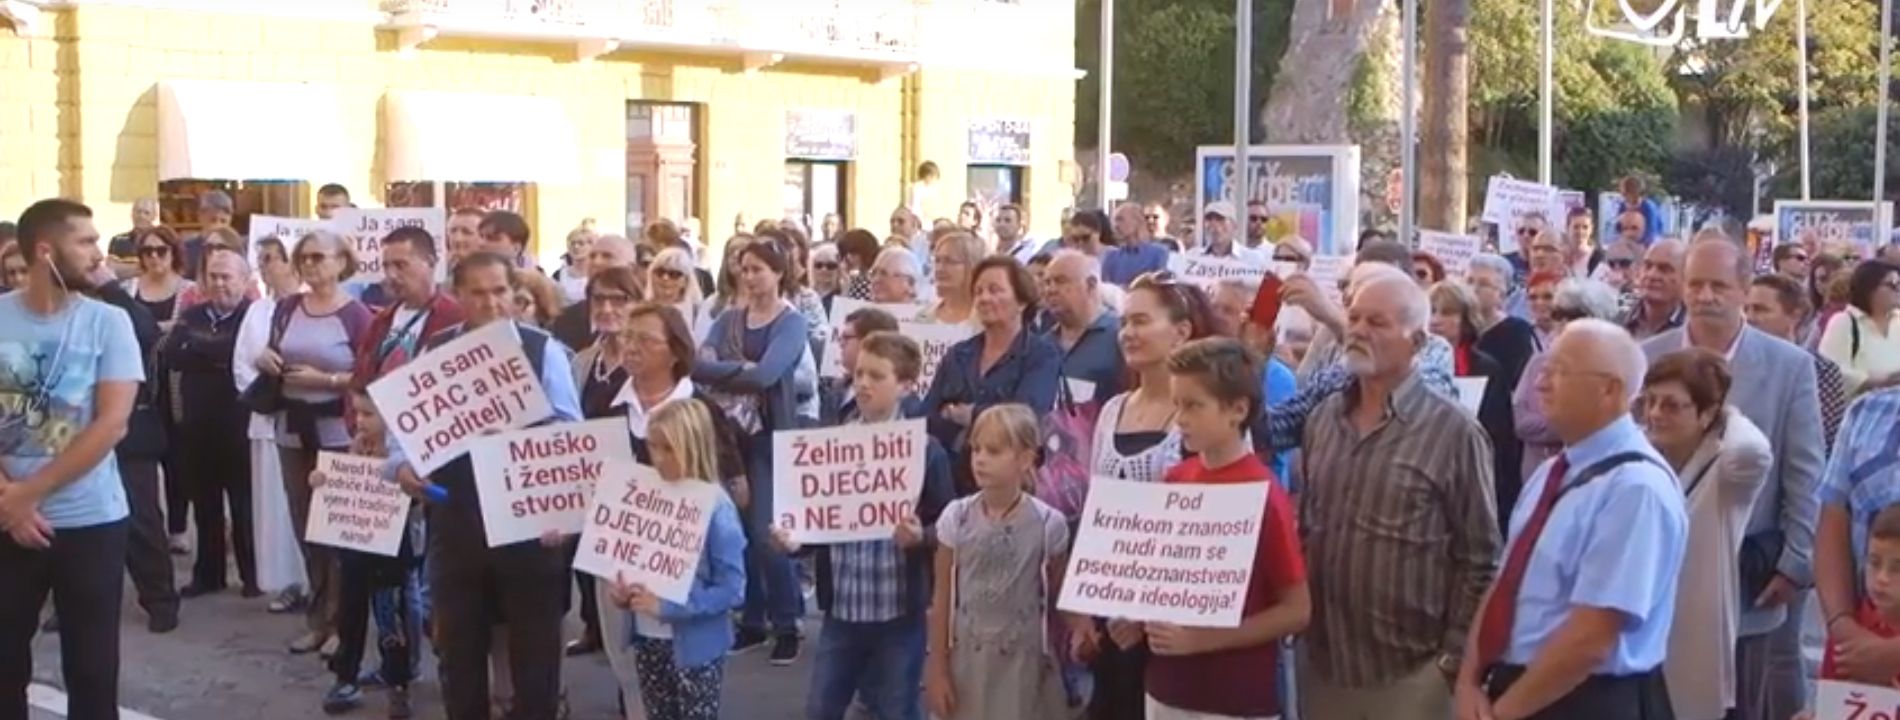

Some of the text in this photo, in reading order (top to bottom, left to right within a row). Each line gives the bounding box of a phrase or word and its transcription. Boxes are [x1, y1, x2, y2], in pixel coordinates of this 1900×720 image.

[1220, 161, 1281, 181] CTY
[1220, 177, 1300, 201] GIDE
[356, 216, 379, 231] Ja
[407, 343, 494, 398] Ja sam
[396, 356, 530, 433] OTAC a NE
[509, 431, 597, 462] Muško
[791, 430, 912, 467] Želim biti
[330, 459, 366, 475] Narod
[503, 467, 512, 492] i
[801, 462, 907, 498] DJEČAK
[323, 494, 350, 509] vjere
[511, 484, 586, 518] stvori
[622, 478, 674, 516] Želim
[1164, 491, 1204, 511] Pod
[781, 511, 796, 529] a
[805, 504, 843, 531] NE
[1092, 508, 1256, 536] krinkom znanosti
[594, 537, 608, 554] a
[613, 538, 642, 566] NE
[1111, 538, 1228, 561] nudi nam se
[1075, 557, 1247, 585] pseudoznanstvena
[1076, 579, 1238, 615] rodna ideologija!
